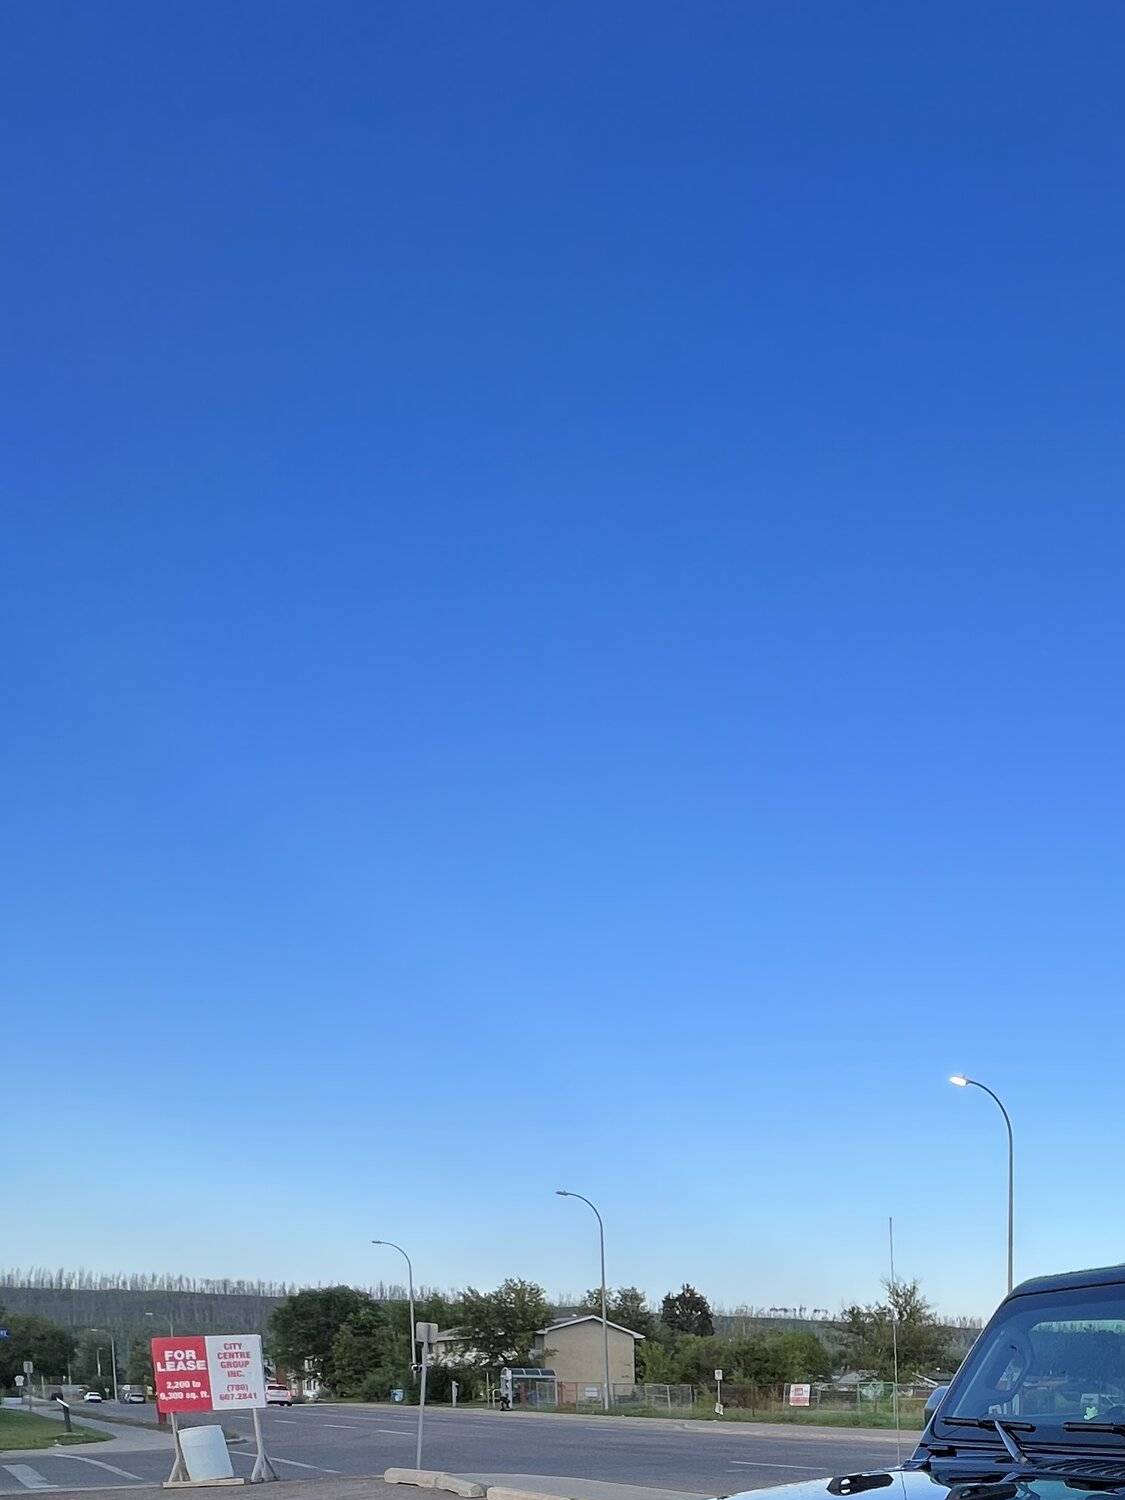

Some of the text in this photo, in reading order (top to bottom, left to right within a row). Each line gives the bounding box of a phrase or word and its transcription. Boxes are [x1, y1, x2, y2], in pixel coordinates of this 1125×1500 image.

[223, 1342, 242, 1350] CITY
[164, 1350, 196, 1360] FOR
[156, 1360, 207, 1372] LEASE
